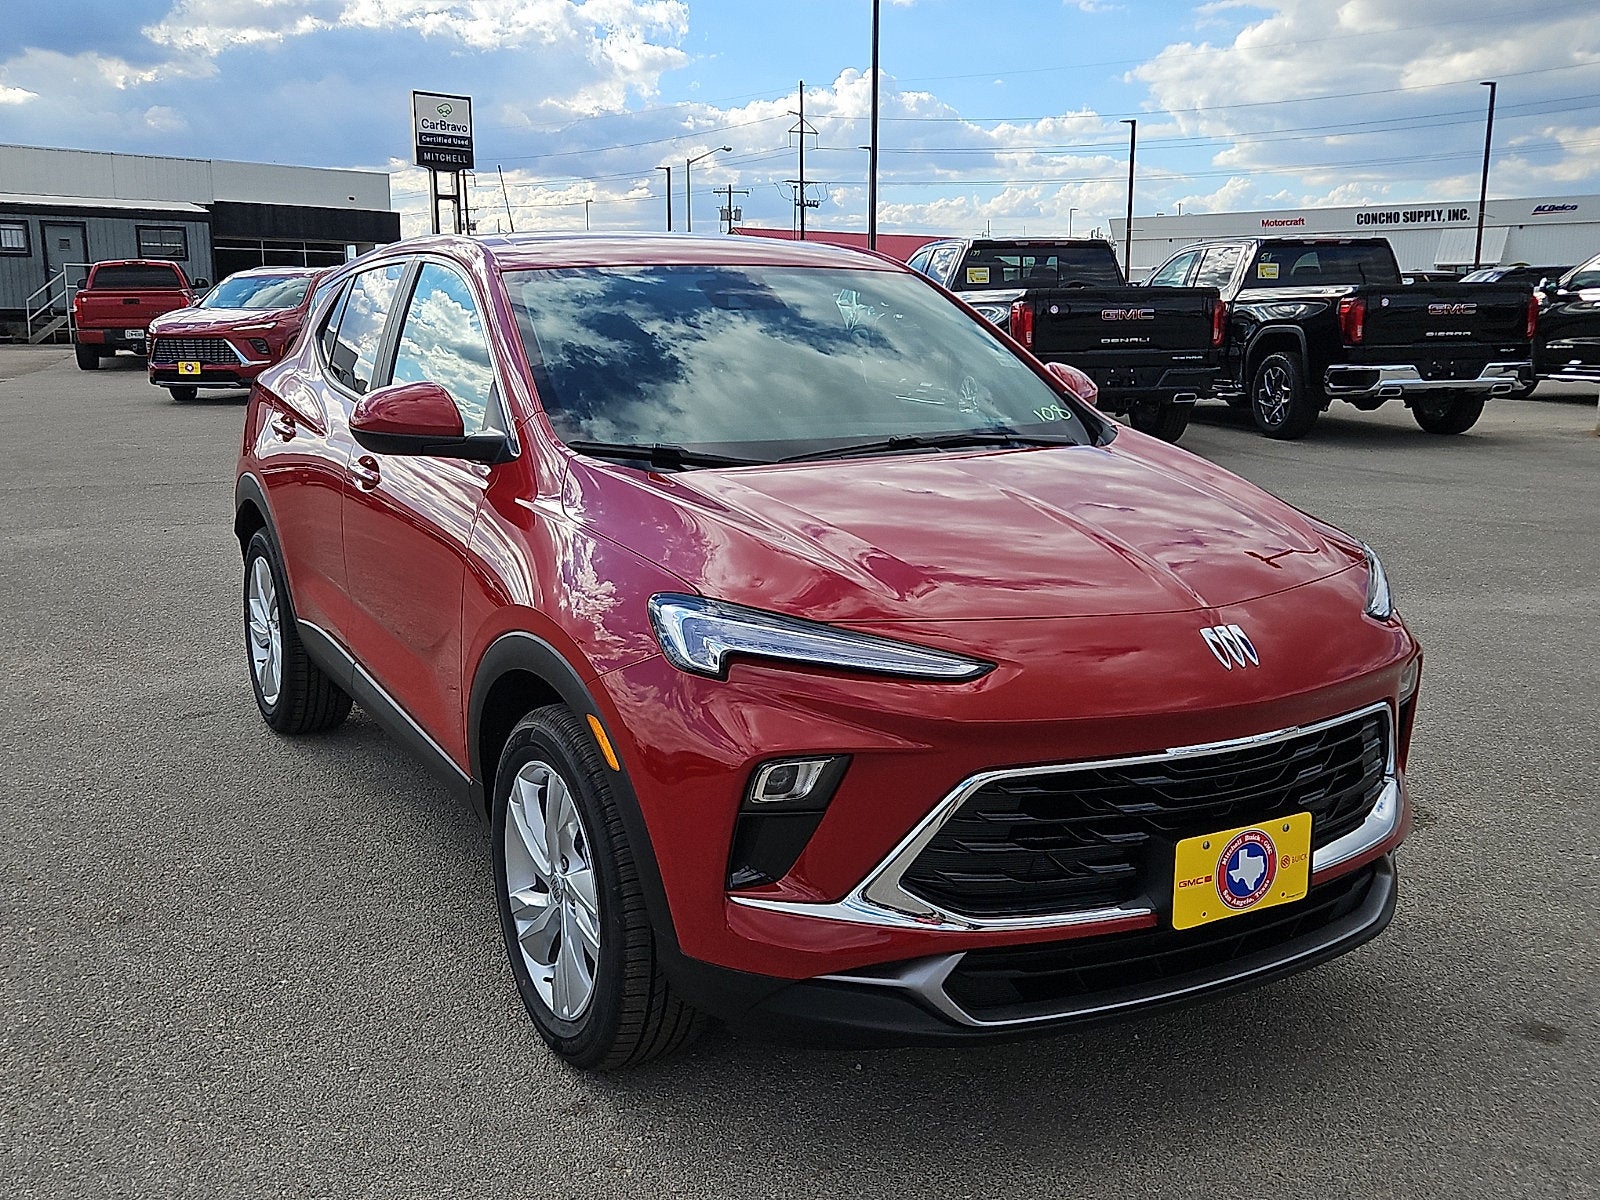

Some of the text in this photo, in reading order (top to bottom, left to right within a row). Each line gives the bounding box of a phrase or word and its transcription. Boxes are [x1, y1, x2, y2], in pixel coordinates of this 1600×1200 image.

[421, 118, 468, 132] CarBravo
[422, 135, 469, 146] Certified Used
[424, 152, 468, 163] MITCHELL
[1261, 218, 1306, 227] Motorcraft
[1356, 208, 1471, 225] CONCHO SUPPLY, INC.
[1101, 308, 1155, 321] GMC
[1428, 303, 1478, 315] GMC
[1032, 403, 1071, 421] 108
[1244, 833, 1261, 842] Buick
[1263, 840, 1273, 855] GMC
[1178, 877, 1204, 888] GMC
[1222, 889, 1232, 902] San
